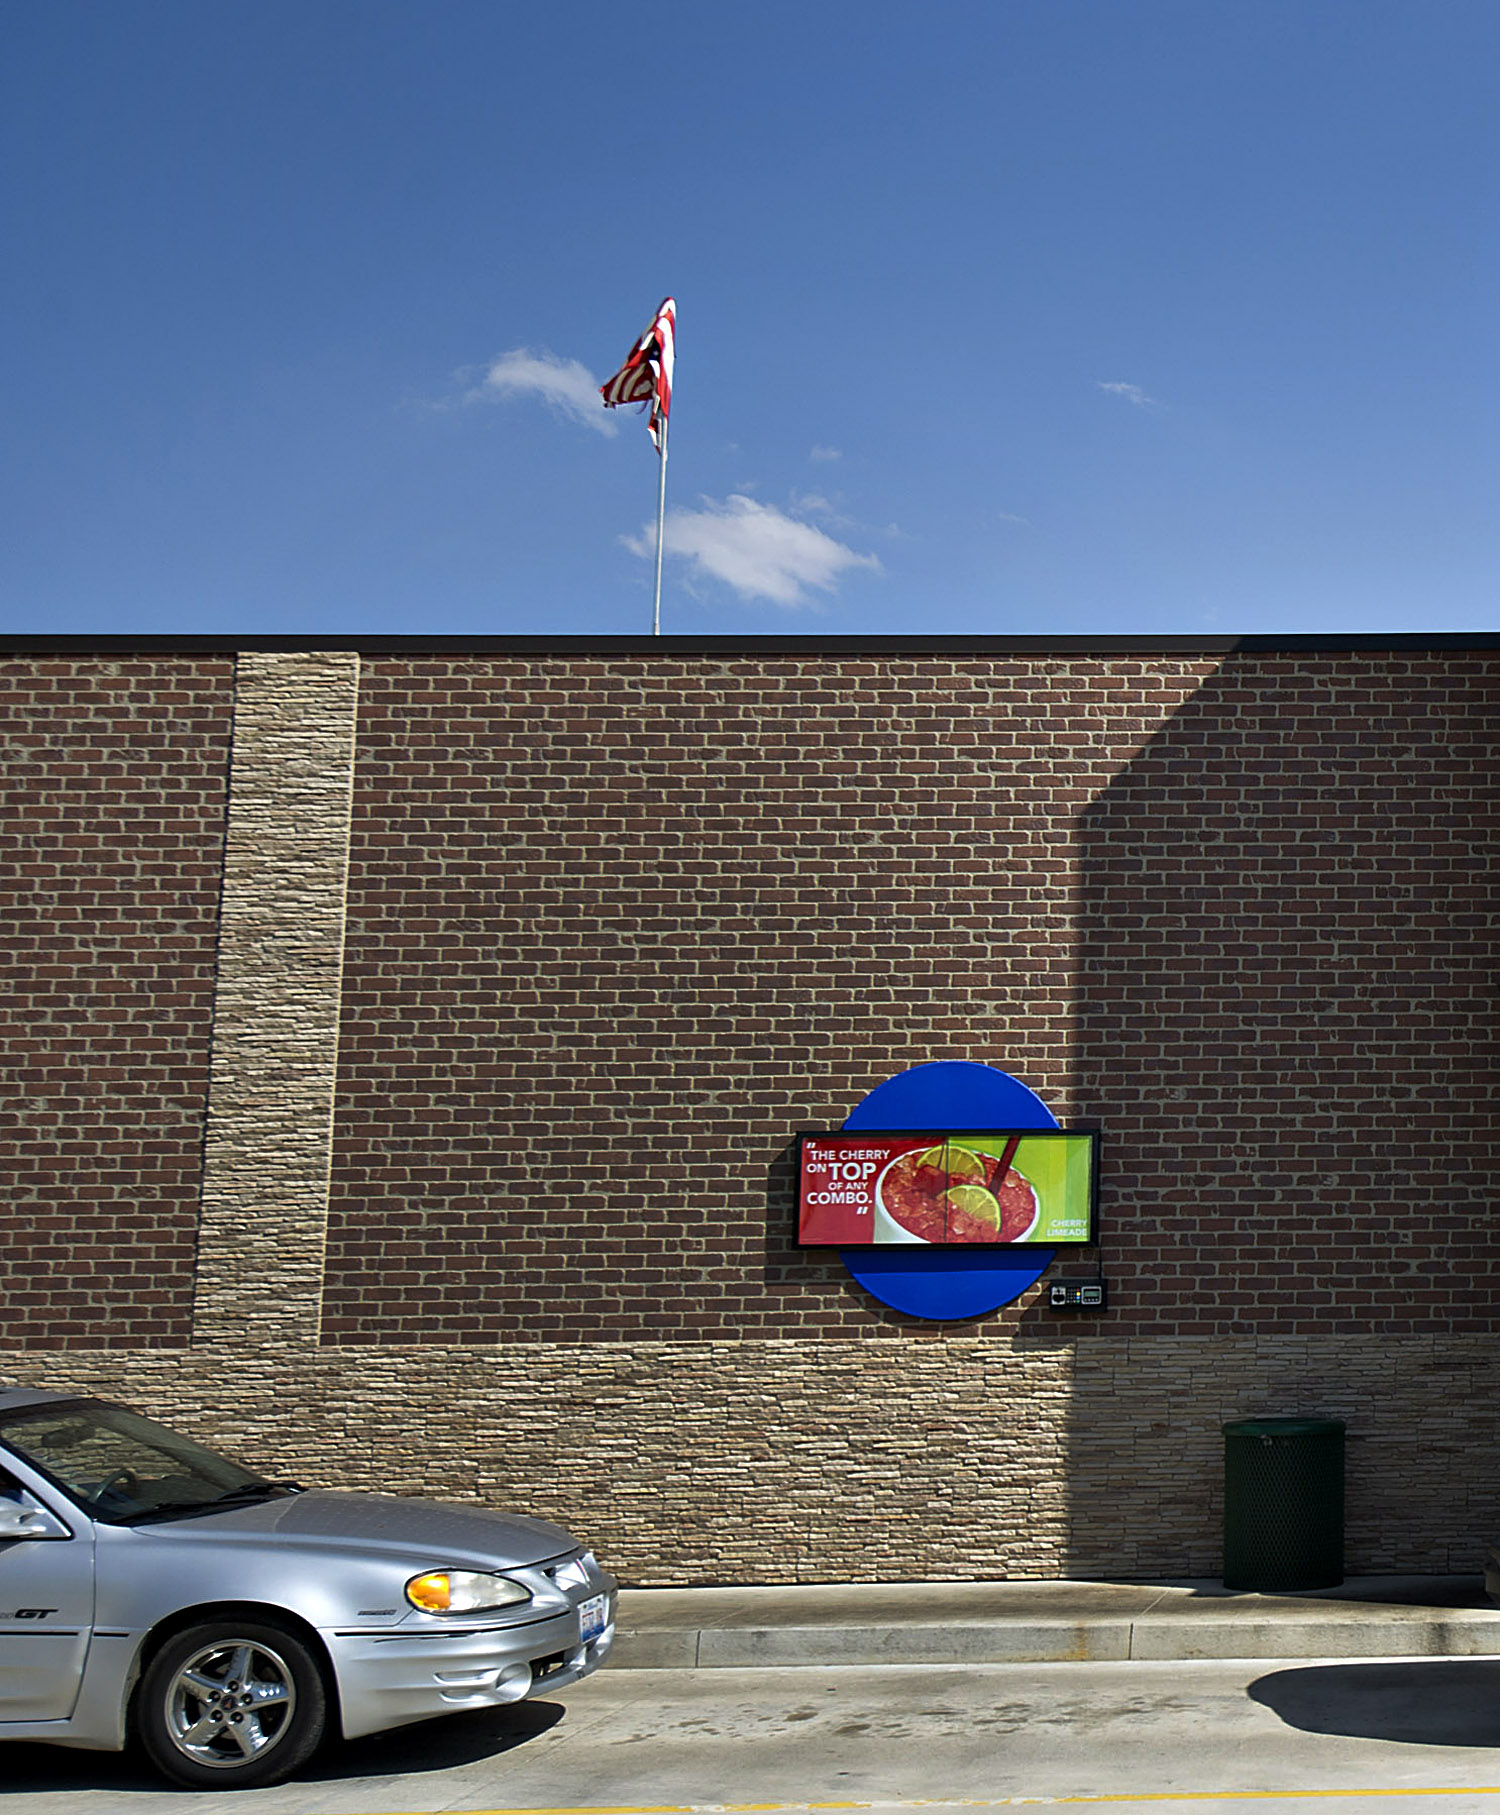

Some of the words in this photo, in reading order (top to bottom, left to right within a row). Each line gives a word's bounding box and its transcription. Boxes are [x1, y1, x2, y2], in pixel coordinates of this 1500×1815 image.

[810, 1150, 836, 1160] THE
[839, 1149, 891, 1160] CHERRY
[806, 1163, 827, 1173] ON
[828, 1162, 877, 1180] TOP
[828, 1182, 844, 1190] OF
[845, 1181, 869, 1190] ANY
[807, 1191, 873, 1205] COMBO.
[1050, 1218, 1087, 1228] CHERRY
[1046, 1227, 1088, 1237] LIMEADE
[15, 1608, 59, 1619] GT
